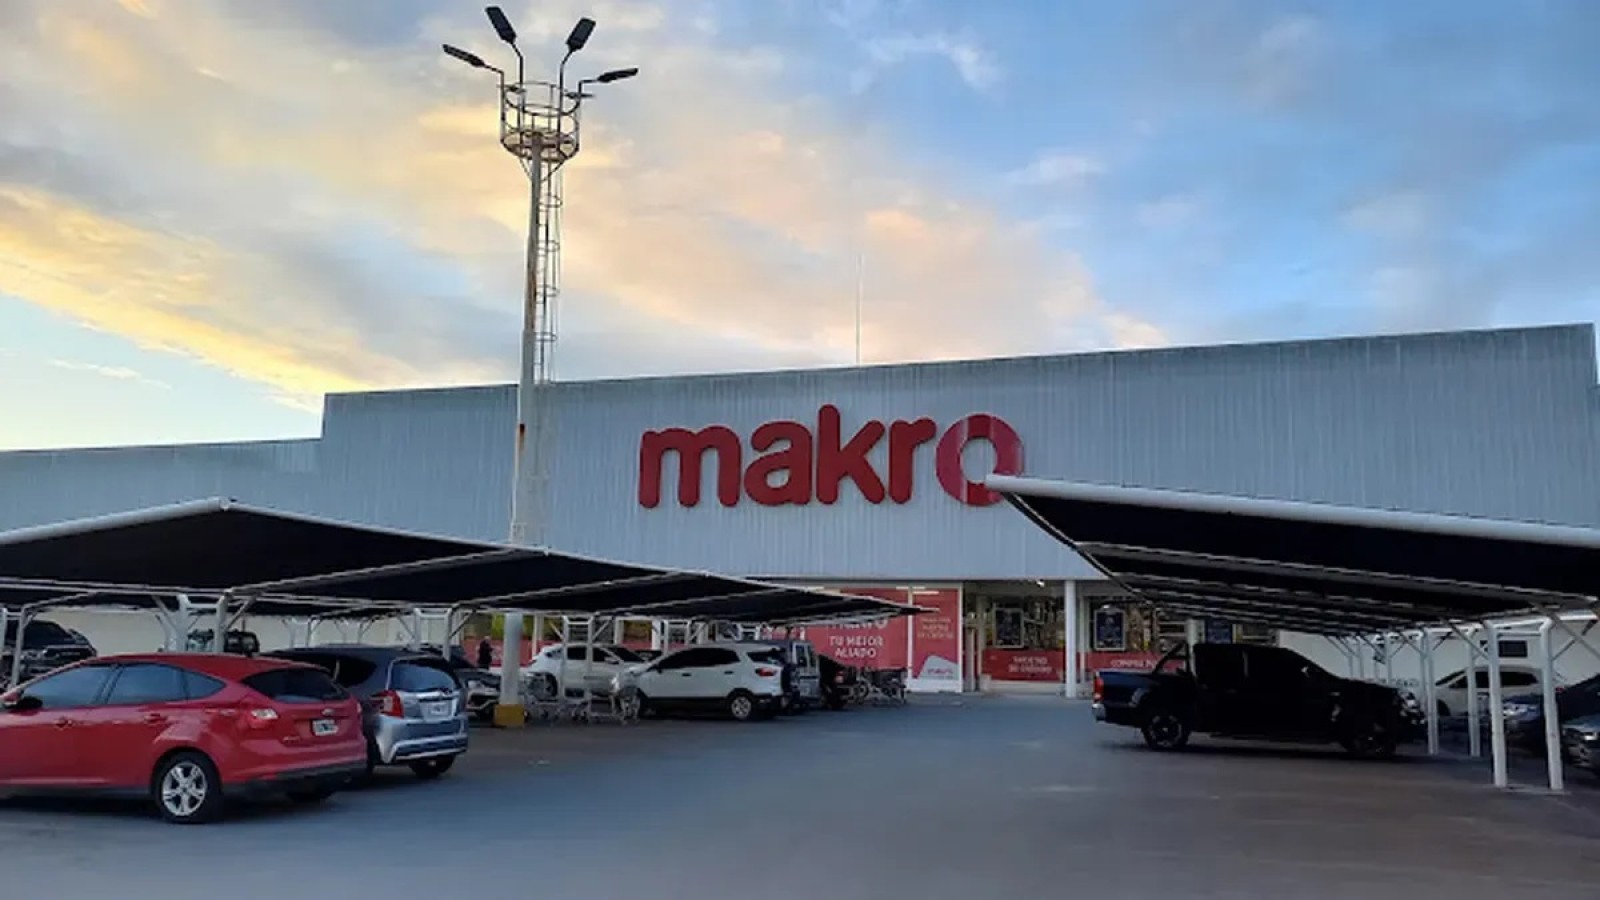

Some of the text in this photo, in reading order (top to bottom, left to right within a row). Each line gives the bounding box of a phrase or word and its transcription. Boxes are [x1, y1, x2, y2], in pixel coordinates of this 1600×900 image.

[639, 404, 1024, 507] makro
[829, 635, 884, 647] TU MEJOR
[835, 647, 877, 658] ALIADO
